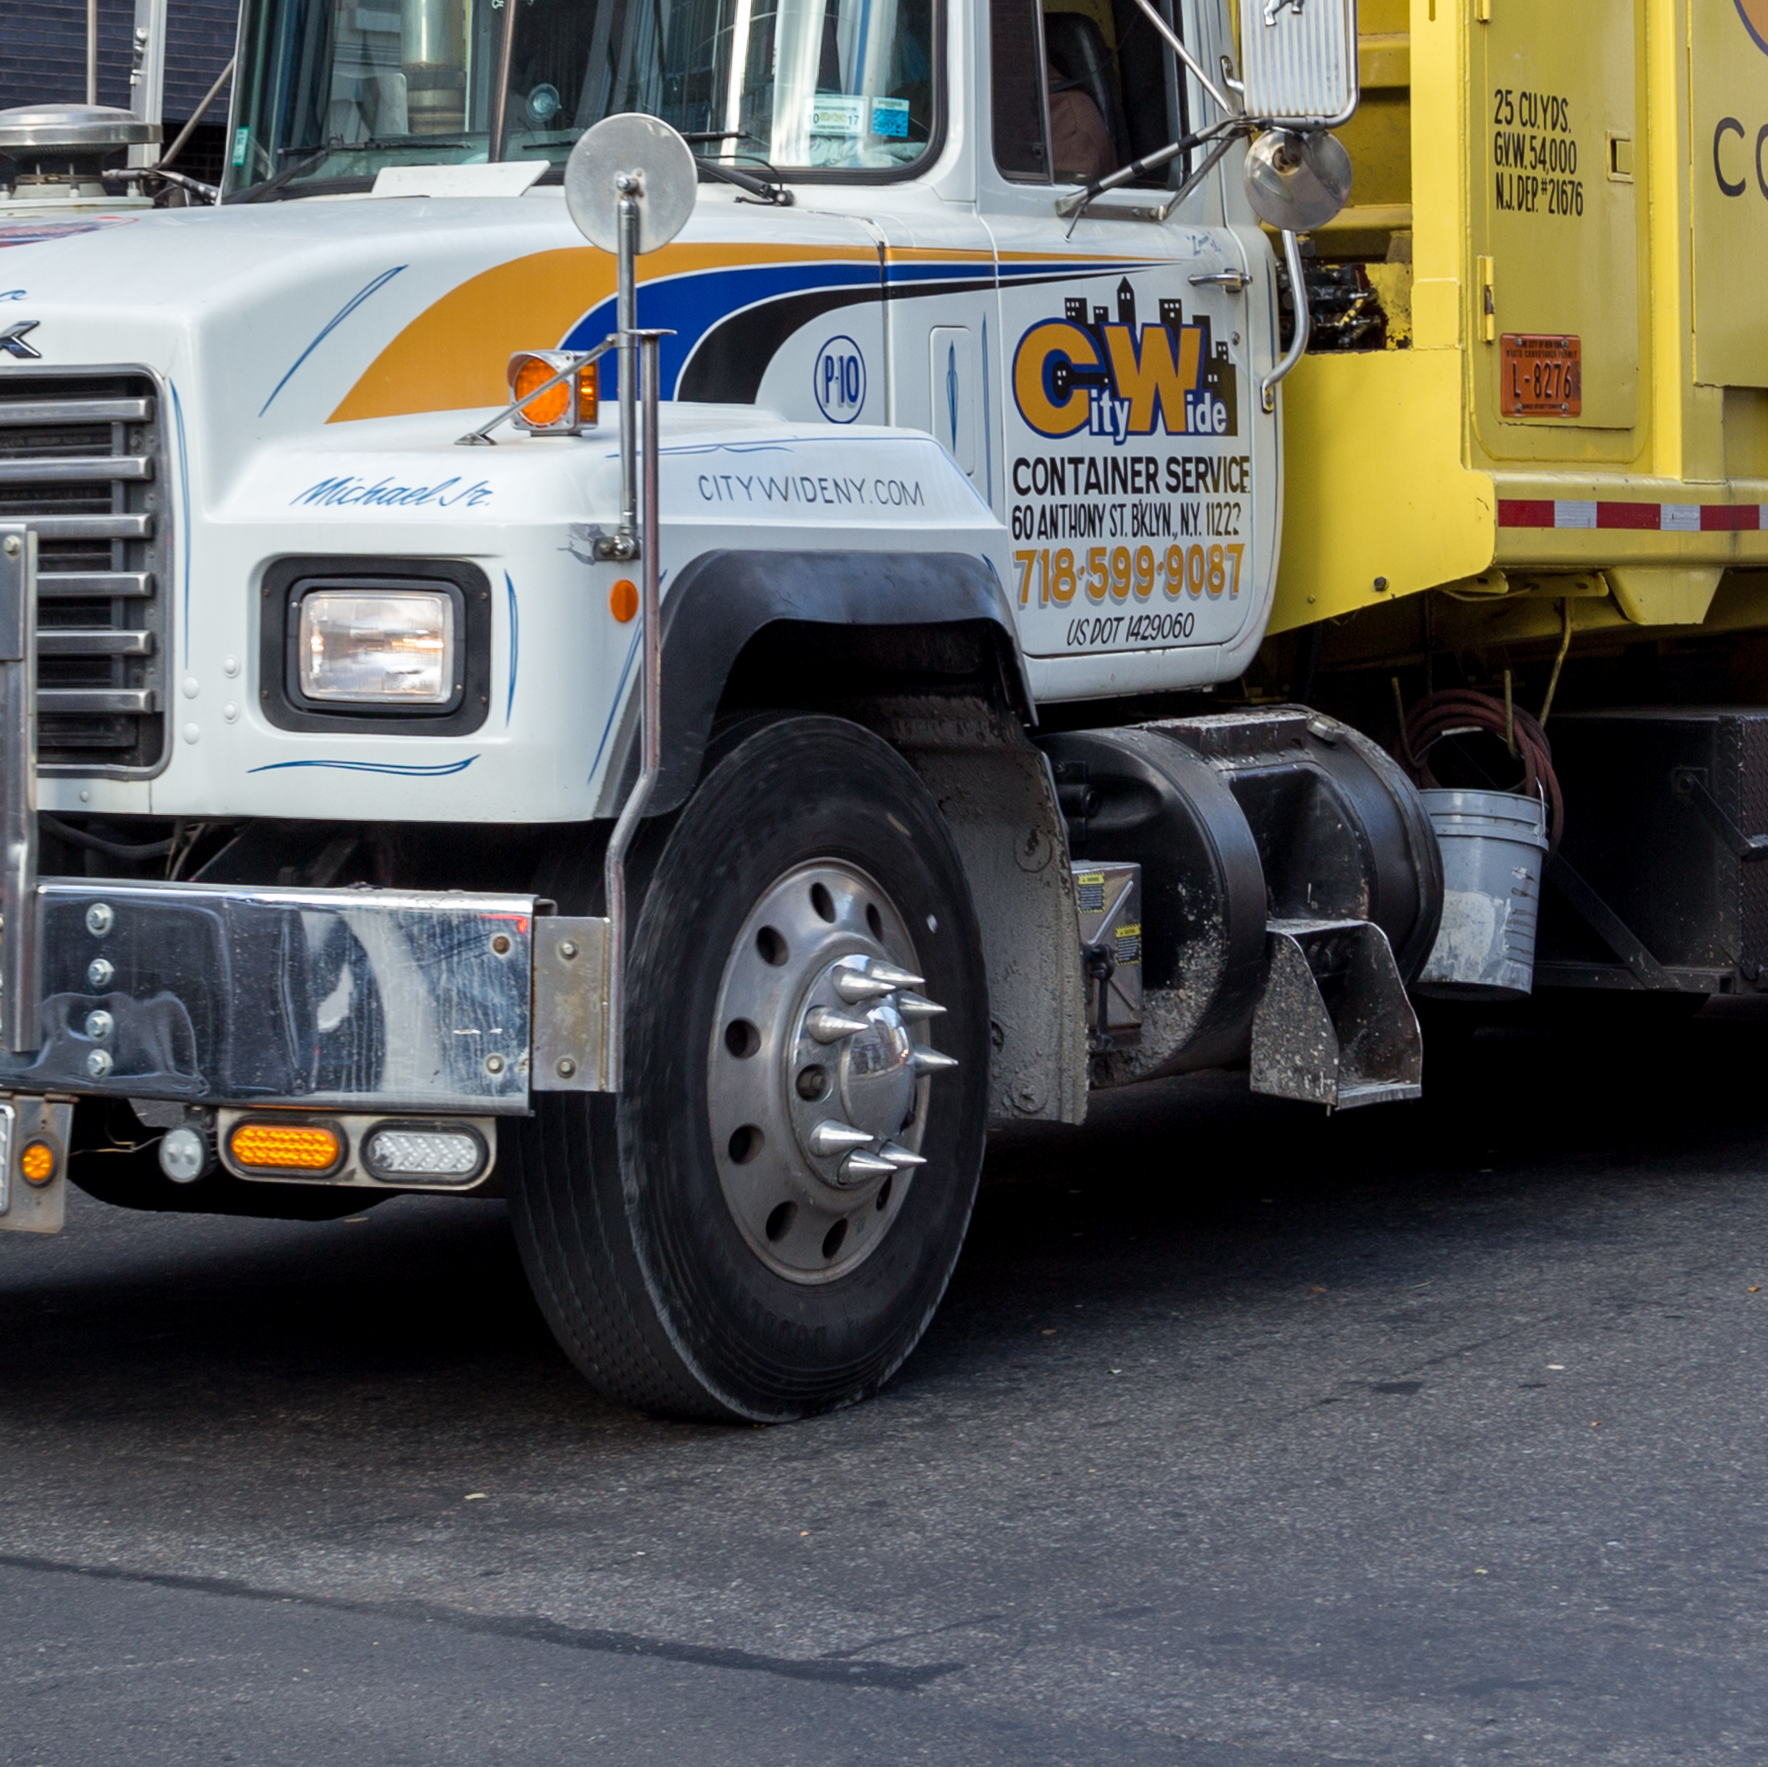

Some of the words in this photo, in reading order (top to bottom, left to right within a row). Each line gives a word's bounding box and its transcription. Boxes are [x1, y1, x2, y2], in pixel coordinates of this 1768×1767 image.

[1493, 88, 1514, 126] 25
[1530, 134, 1578, 176] 54,000
[1512, 361, 1573, 399] L-8276
[288, 475, 462, 507] Michael
[1012, 456, 1160, 496] CONTAINER
[1164, 455, 1251, 494] SERVICE
[1011, 504, 1034, 541] 60
[1036, 503, 1106, 541] ANTHONY
[1109, 503, 1128, 538] ST.
[1180, 502, 1202, 539] N.Y.
[1205, 501, 1243, 537] 11222
[1066, 617, 1090, 647] US
[1089, 616, 1125, 645] DOT
[1125, 611, 1195, 643] 1429060
